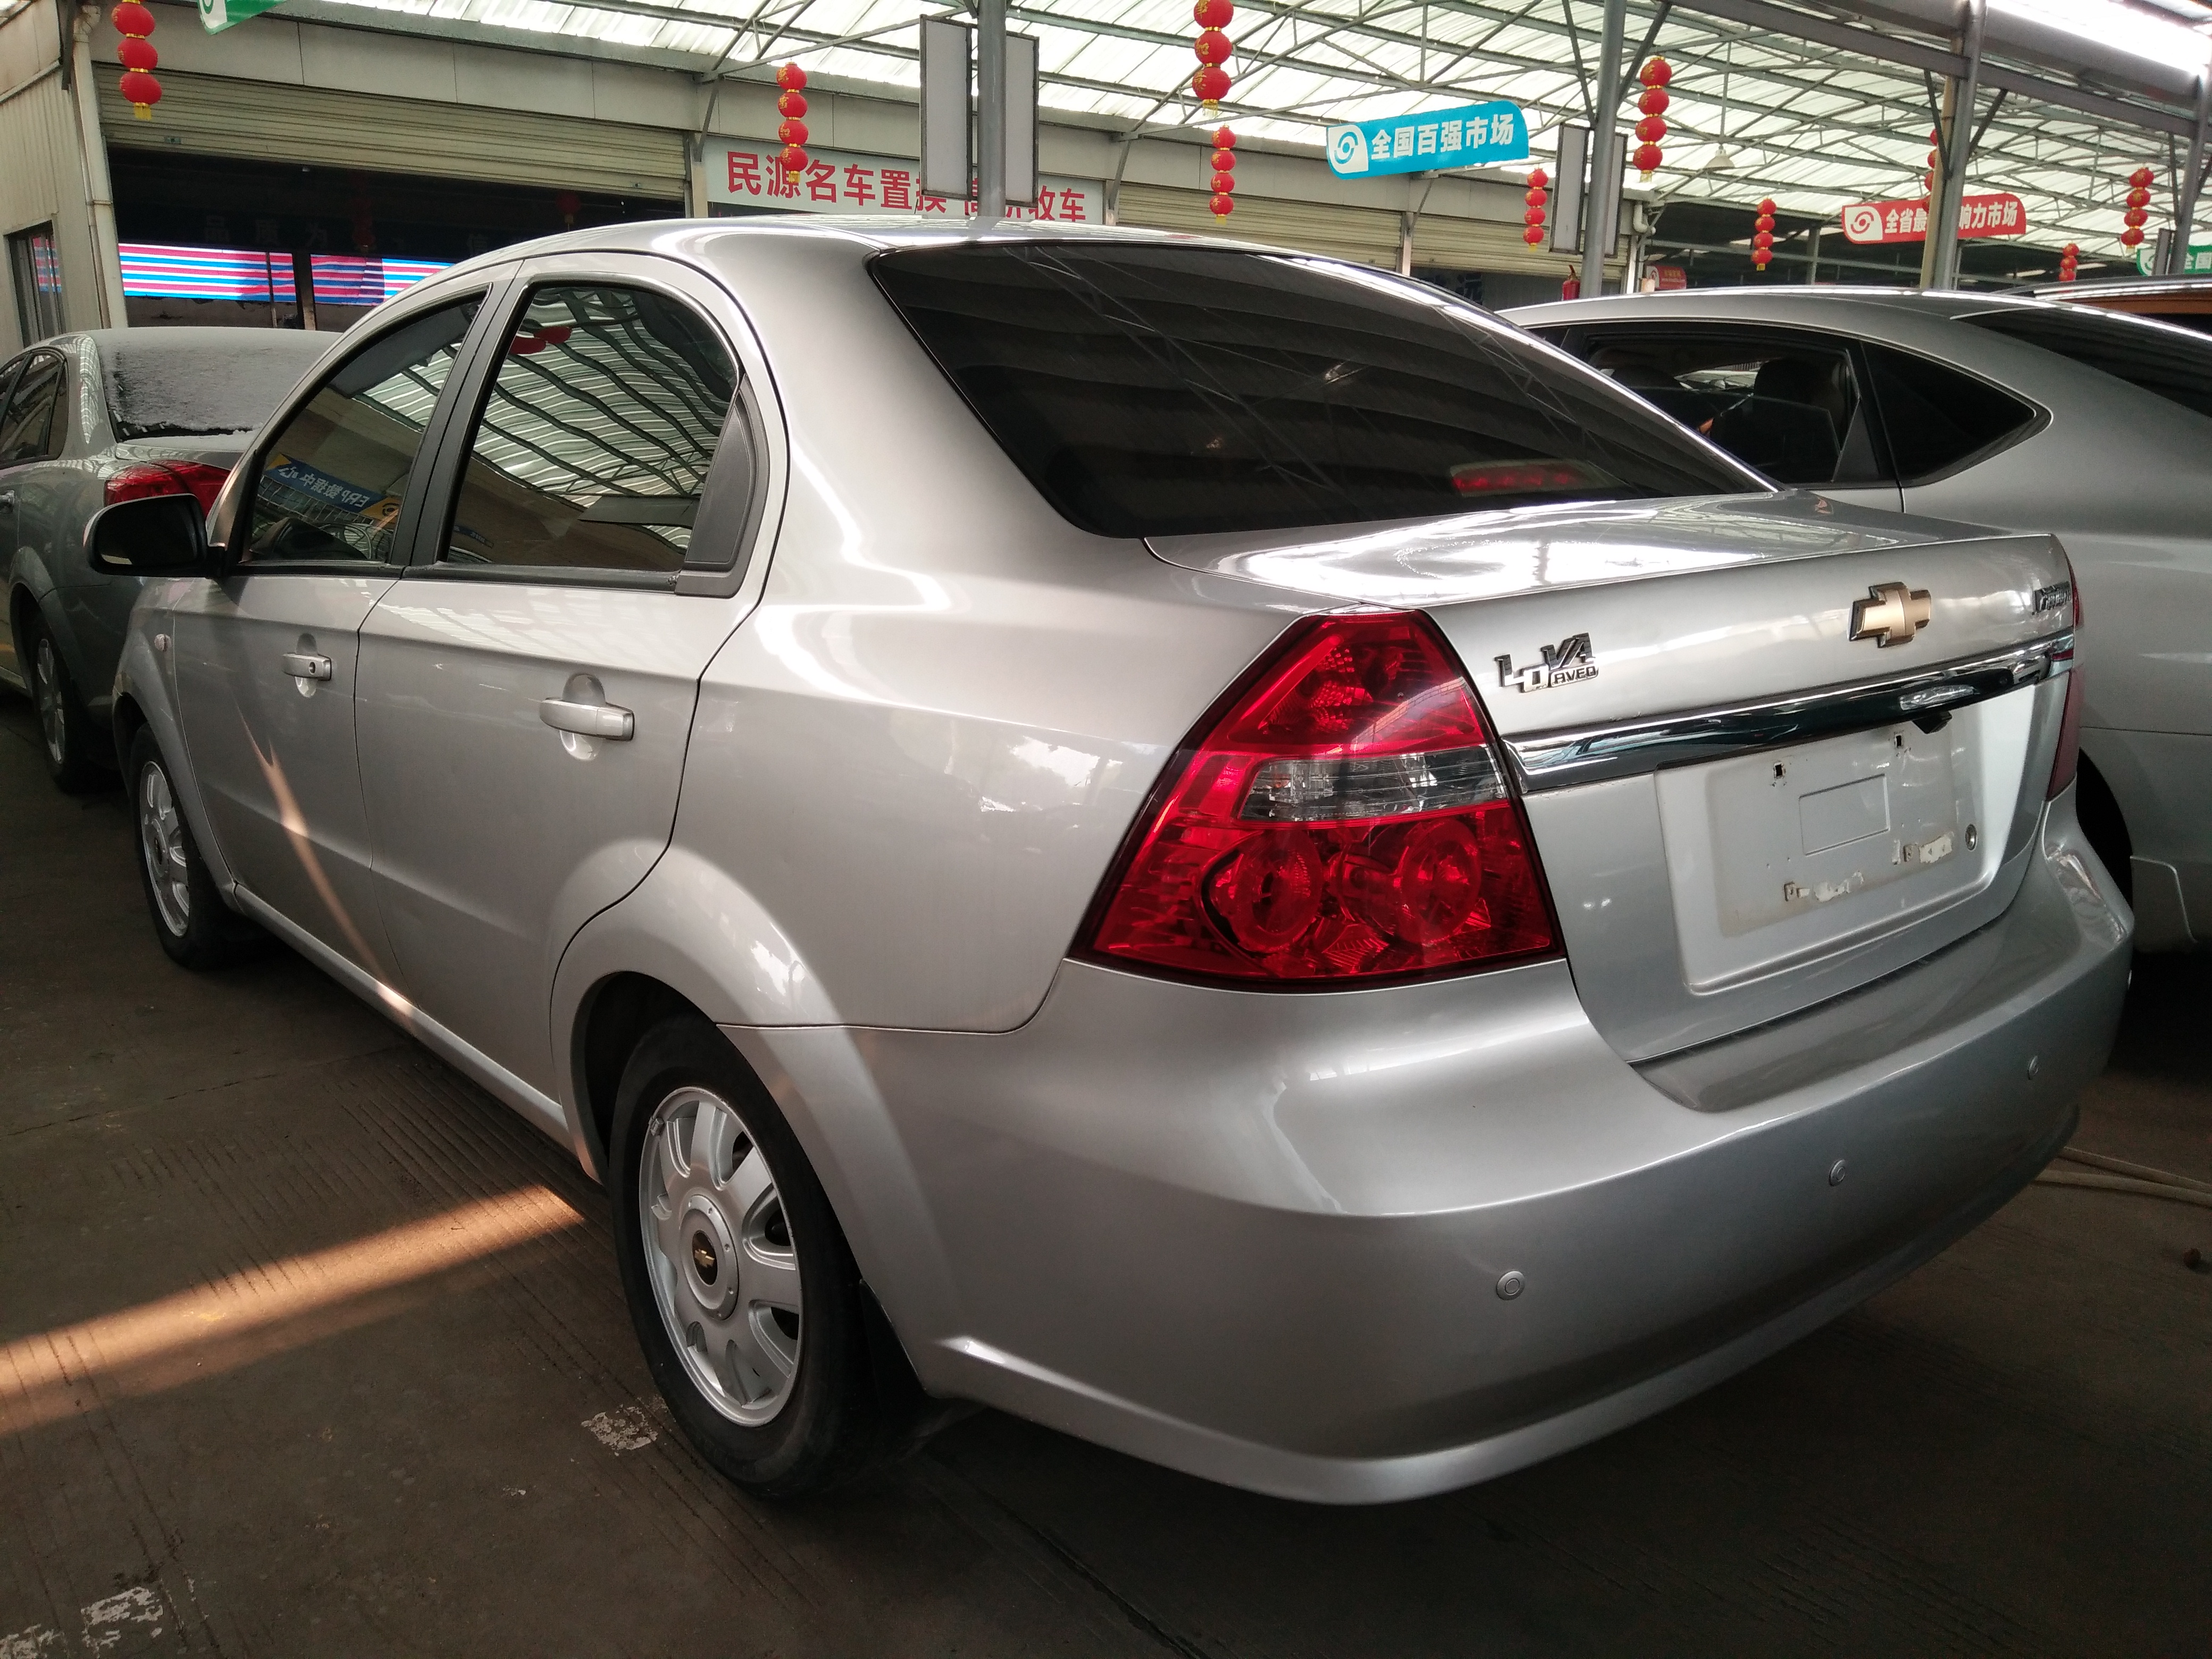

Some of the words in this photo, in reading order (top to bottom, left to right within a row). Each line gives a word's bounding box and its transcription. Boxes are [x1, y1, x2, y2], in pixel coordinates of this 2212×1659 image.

[1371, 113, 1514, 160] 全国百强市场
[1884, 200, 2018, 234] 全省最响力市场
[1553, 665, 1598, 686] AVEO
